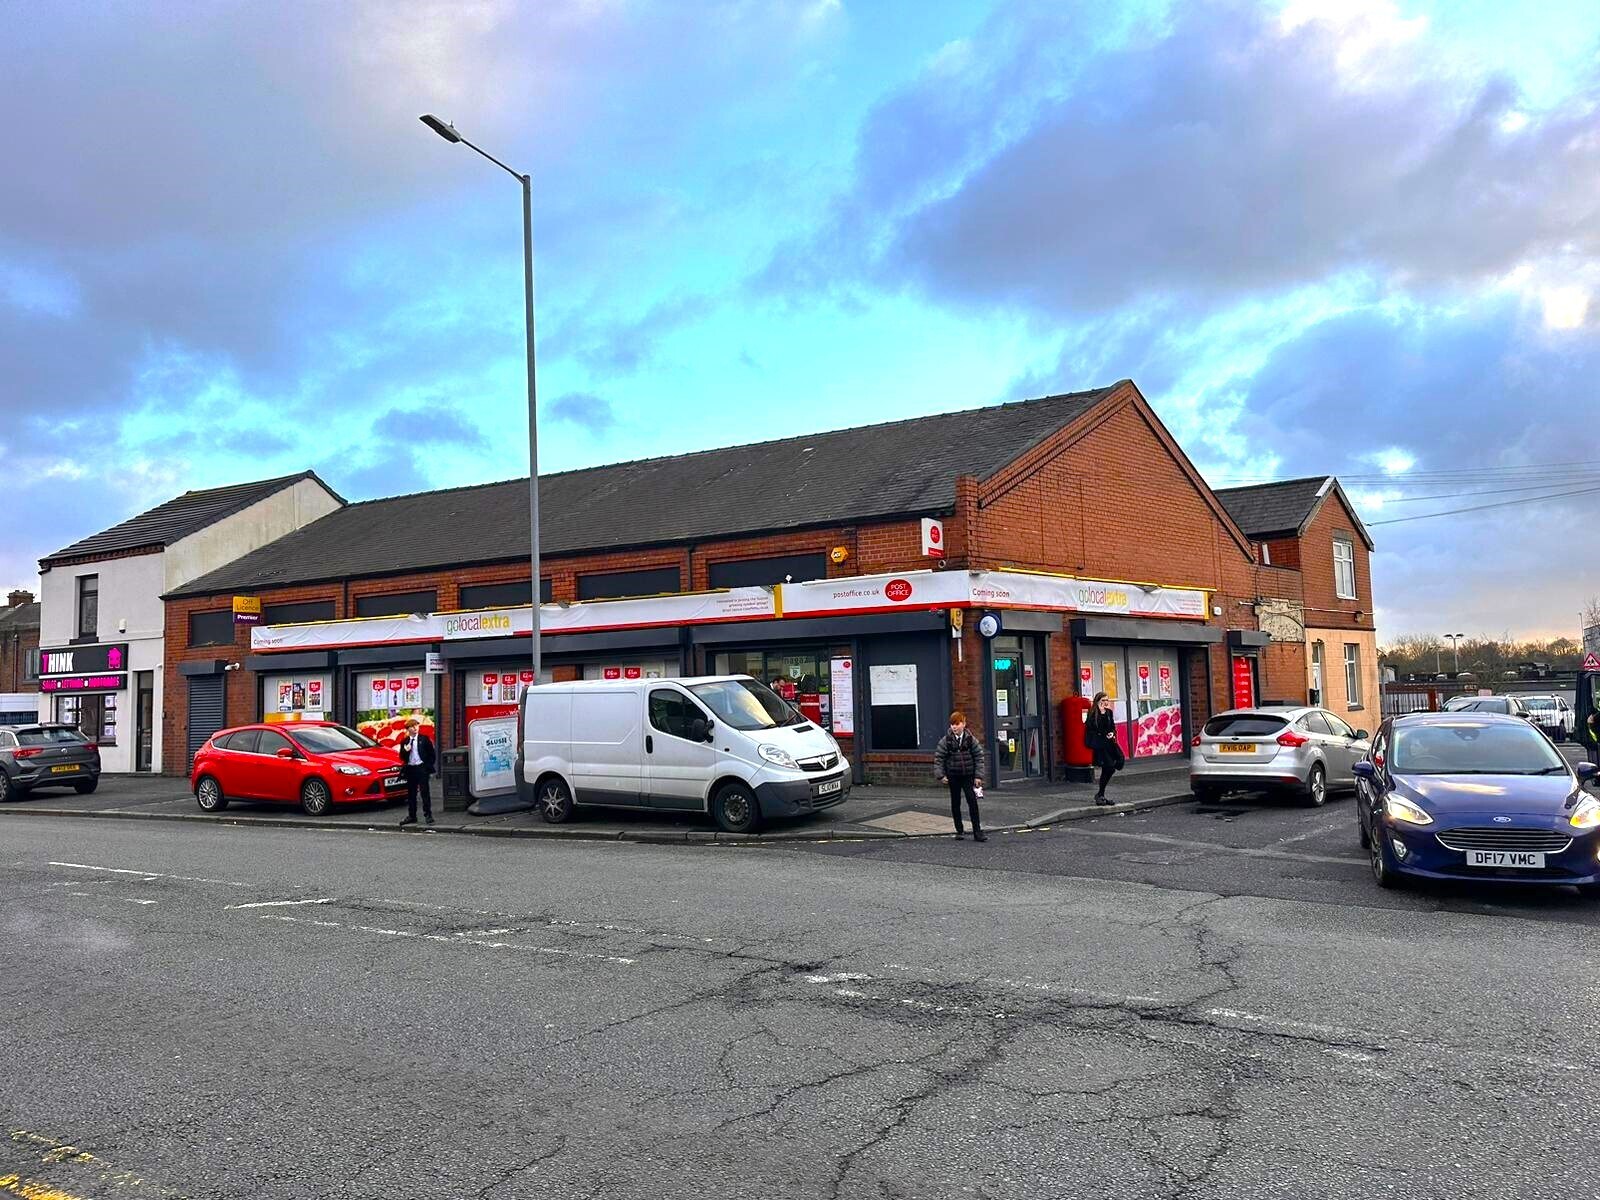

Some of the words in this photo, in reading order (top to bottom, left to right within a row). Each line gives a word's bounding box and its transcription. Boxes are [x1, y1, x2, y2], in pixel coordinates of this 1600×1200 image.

[833, 588, 880, 599] postoffice.co.uk
[972, 588, 995, 597] Coming
[447, 614, 510, 635] golocalextra
[42, 652, 74, 673] THINK
[486, 737, 507, 746] SLUSH
[1475, 852, 1505, 864] DF17
[1509, 853, 1536, 865] VMC
